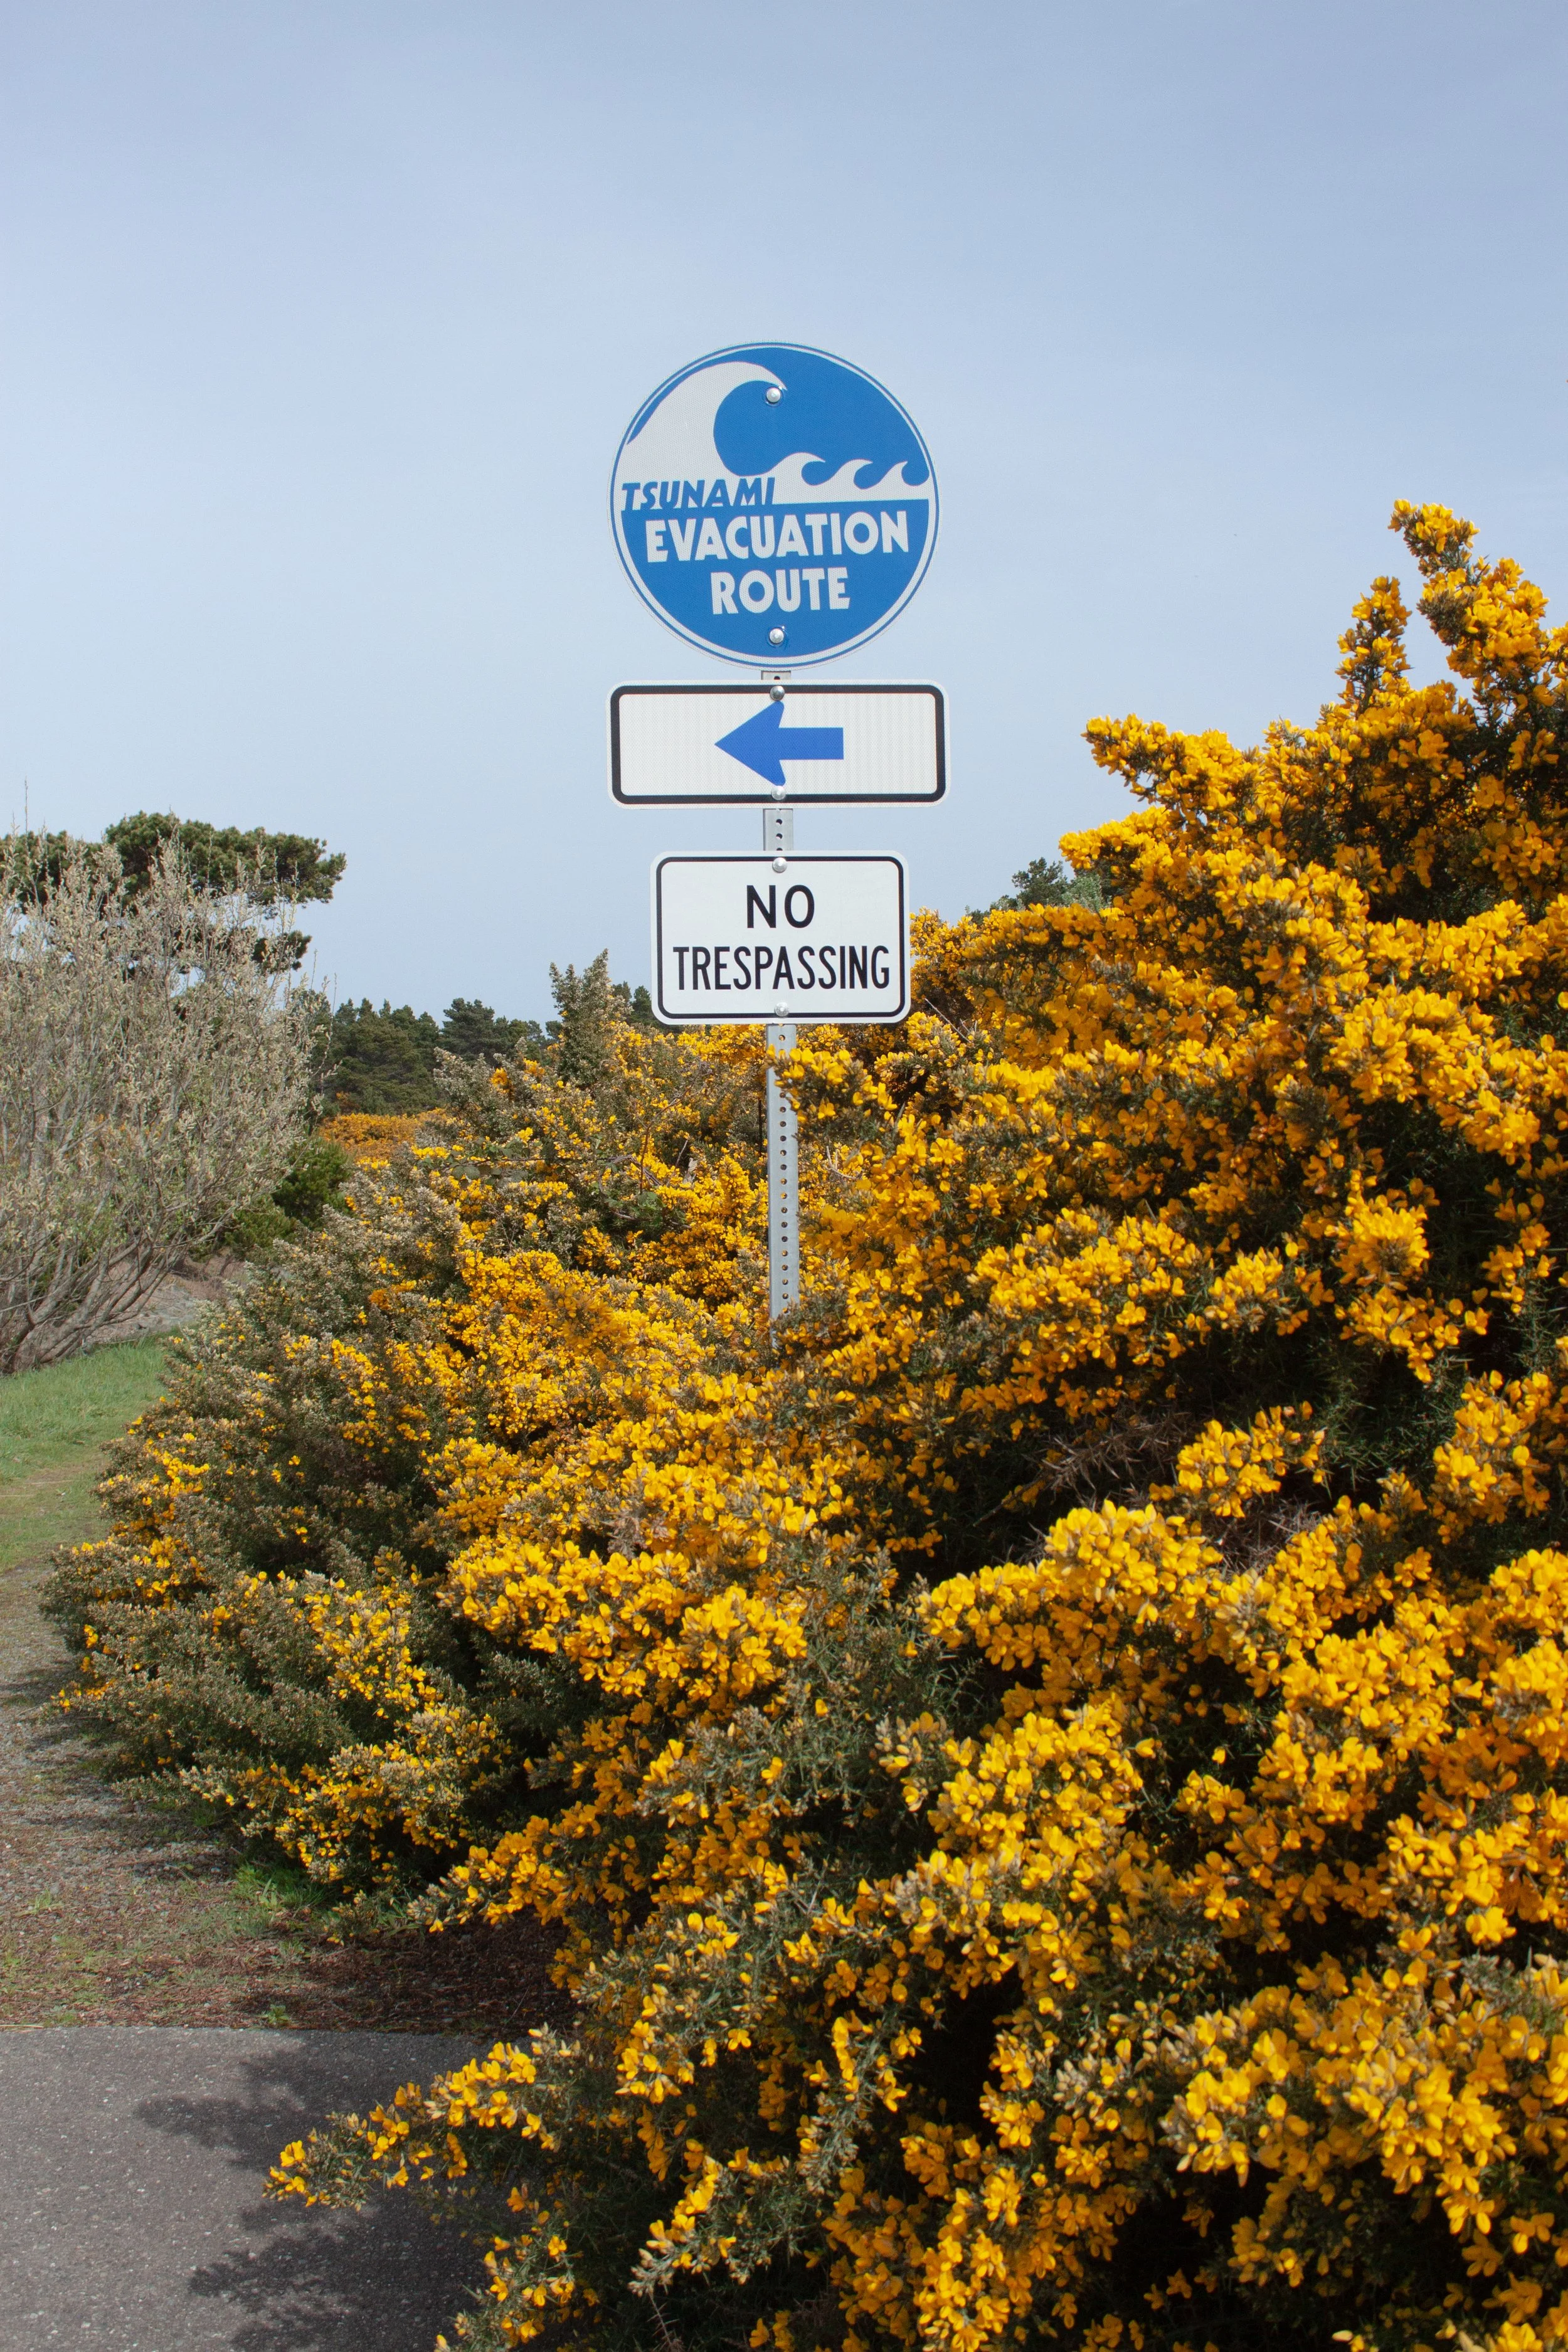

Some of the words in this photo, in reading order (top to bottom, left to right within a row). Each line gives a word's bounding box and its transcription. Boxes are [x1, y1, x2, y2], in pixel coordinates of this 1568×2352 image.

[622, 477, 776, 511] TSUNAMI
[645, 511, 909, 563] EVACUATION
[710, 567, 850, 615] ROUTE
[746, 884, 815, 929] NO
[672, 945, 890, 990] TRESPASSING
